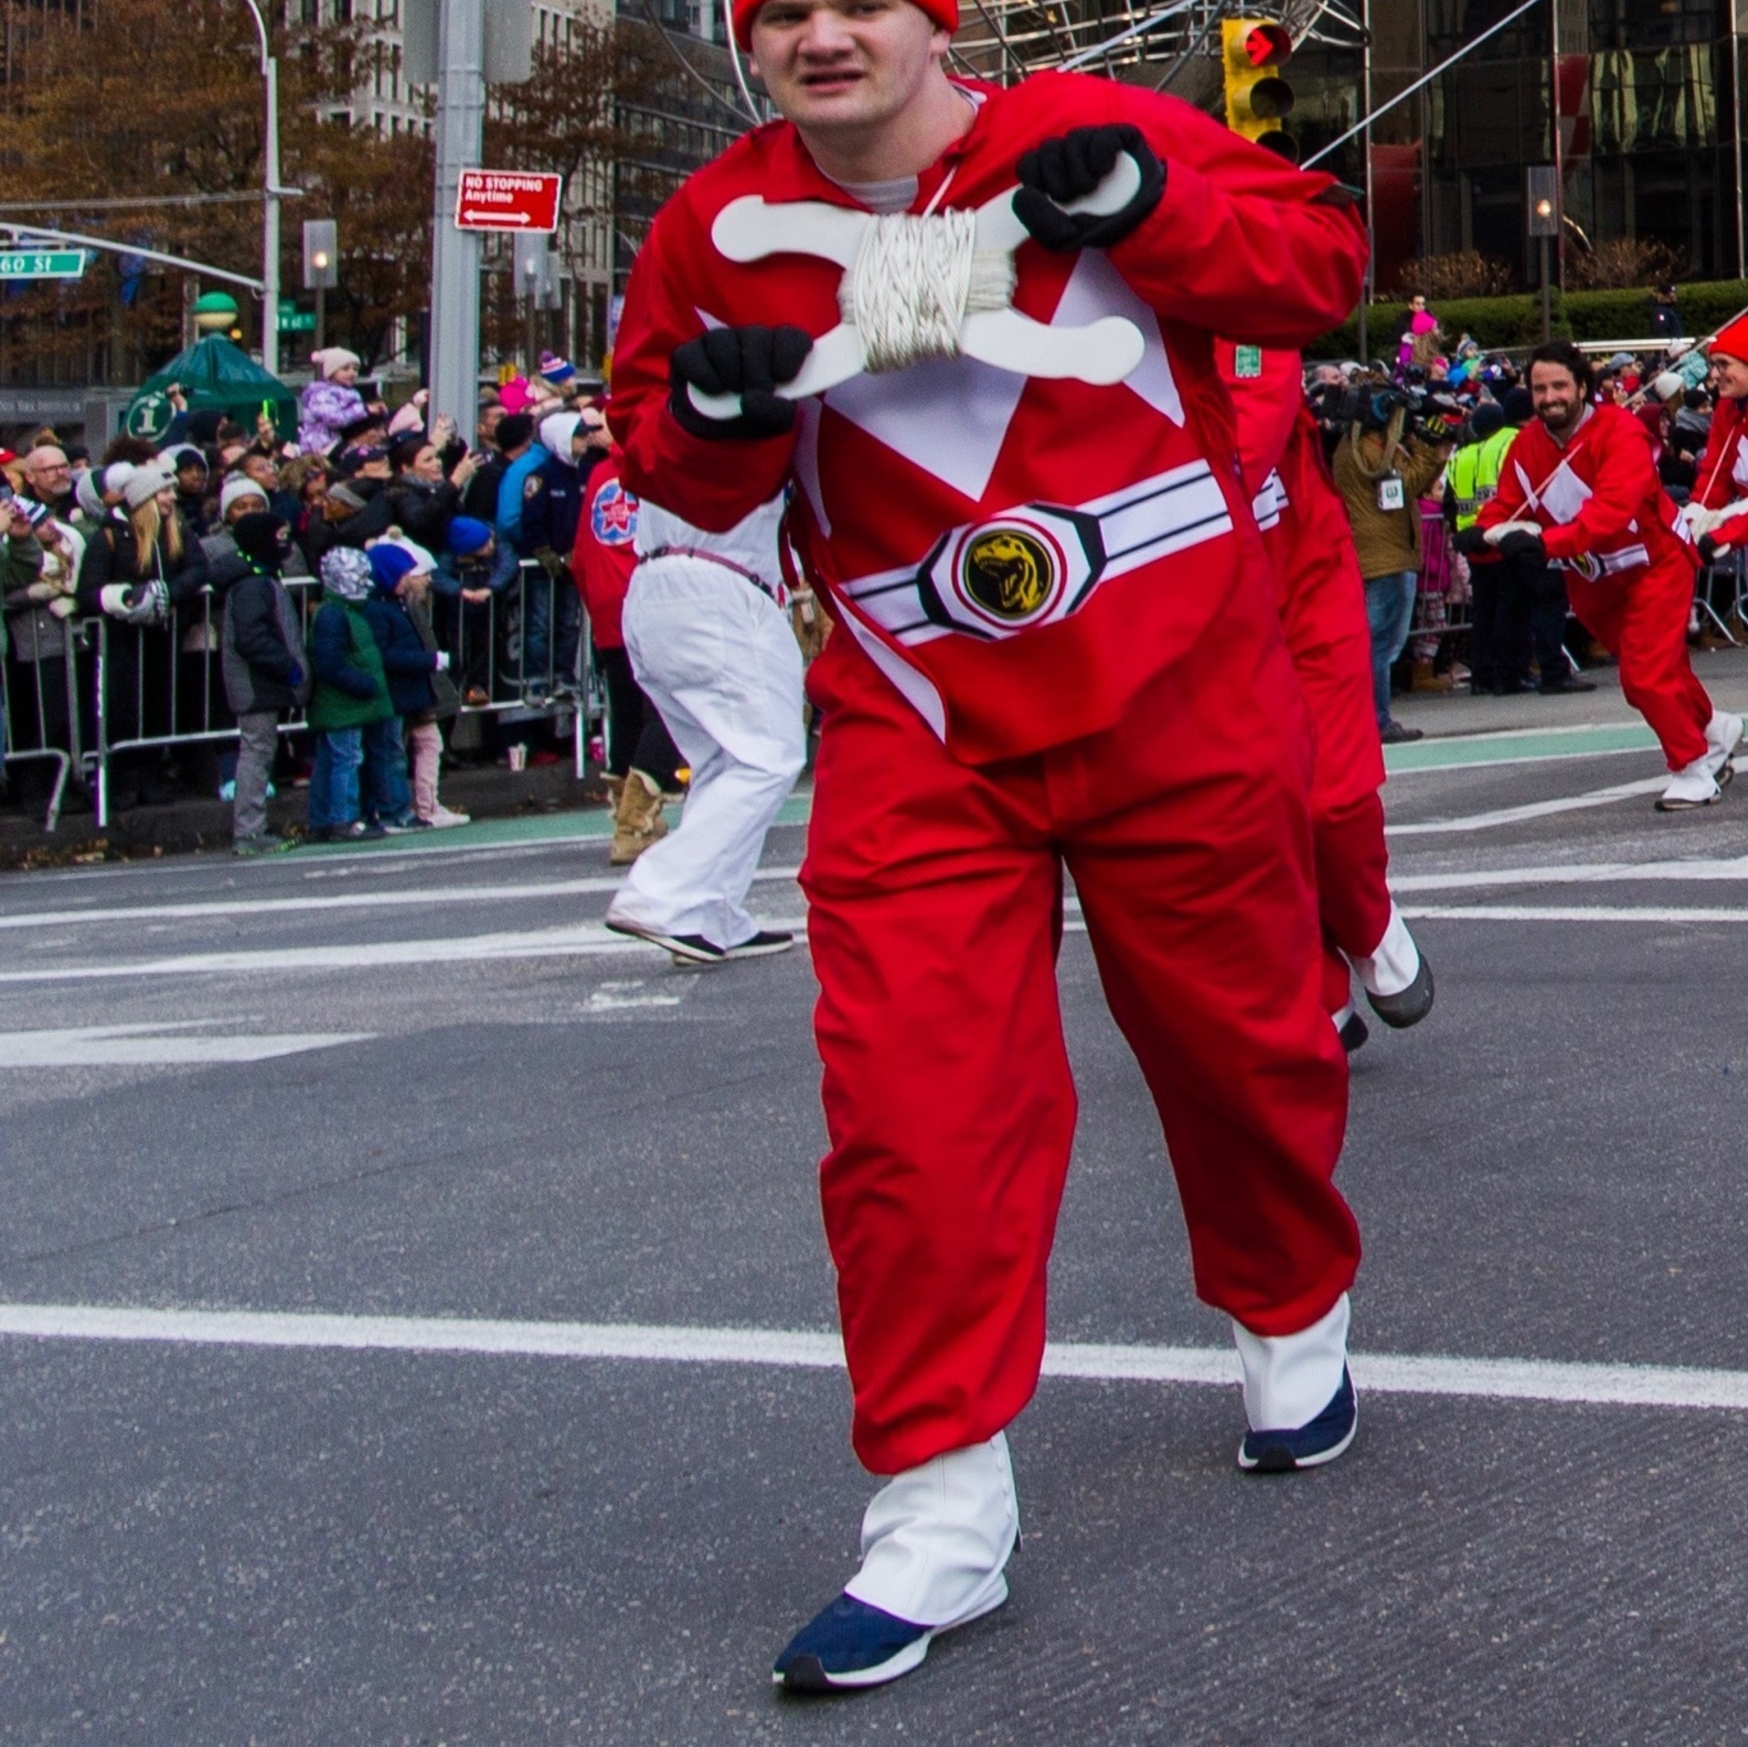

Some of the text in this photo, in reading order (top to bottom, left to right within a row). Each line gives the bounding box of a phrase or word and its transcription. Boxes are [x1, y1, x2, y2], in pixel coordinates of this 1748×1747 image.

[465, 175, 543, 193] NO STOPPING
[464, 188, 514, 204] Anytime
[0, 256, 52, 273] 60 St
